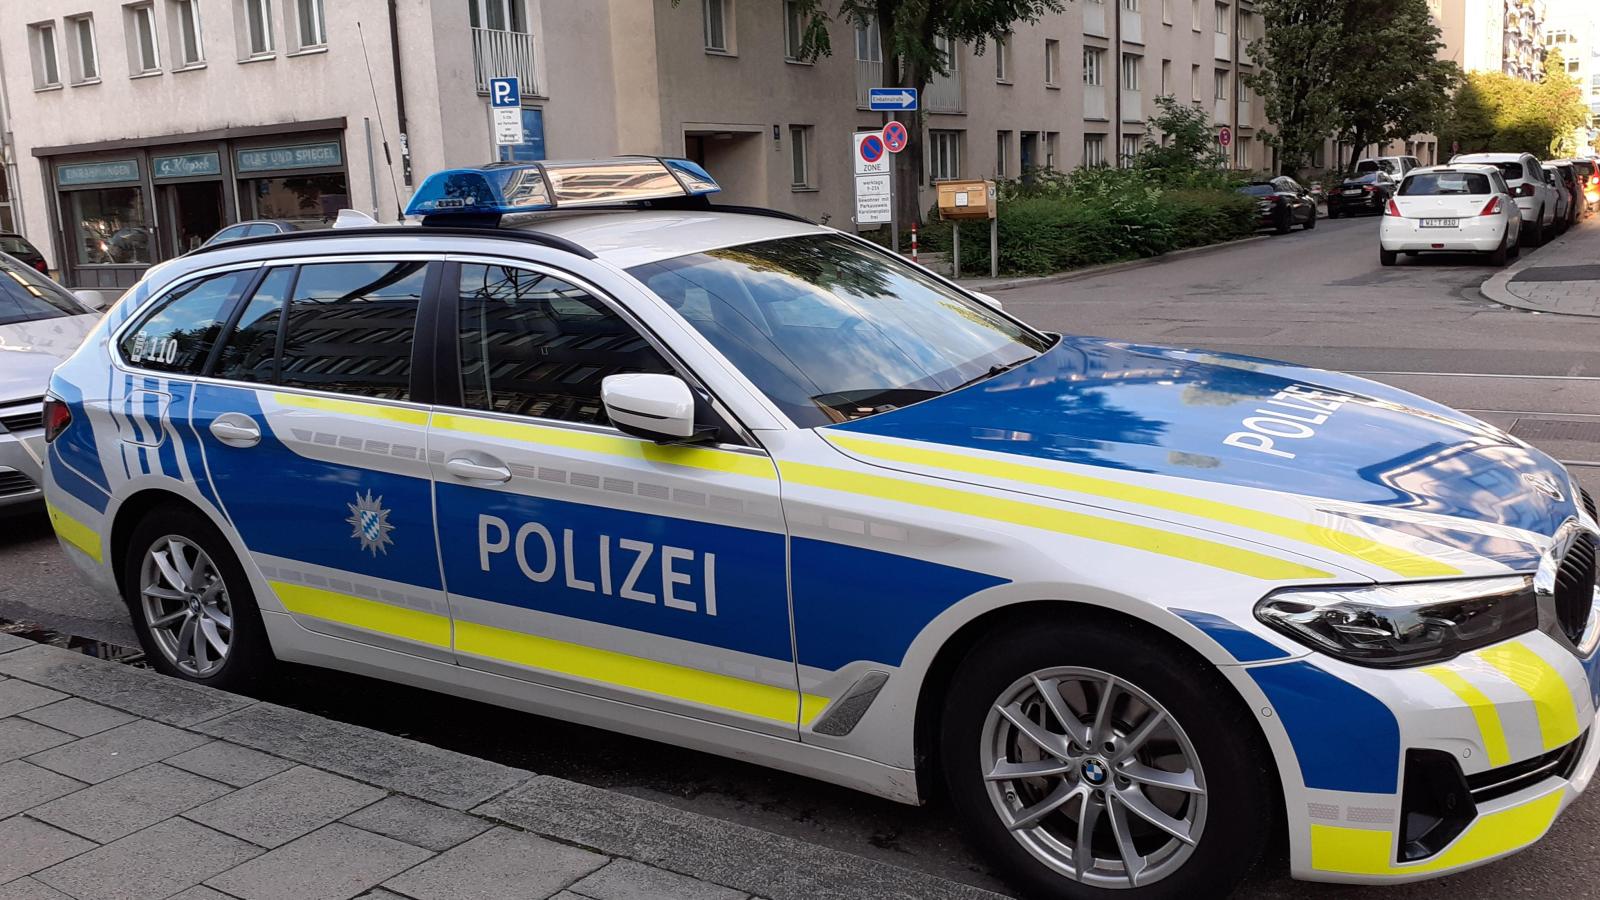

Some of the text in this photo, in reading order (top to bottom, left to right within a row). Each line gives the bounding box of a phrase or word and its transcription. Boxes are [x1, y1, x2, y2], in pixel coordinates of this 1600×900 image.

[494, 81, 511, 104] P
[271, 150, 293, 162] UND
[296, 147, 336, 160] SPIEGEL
[863, 163, 881, 172] ZONE
[147, 336, 178, 364] 110
[1222, 383, 1355, 460] POLIZEI
[478, 513, 717, 617] POLIZEI
